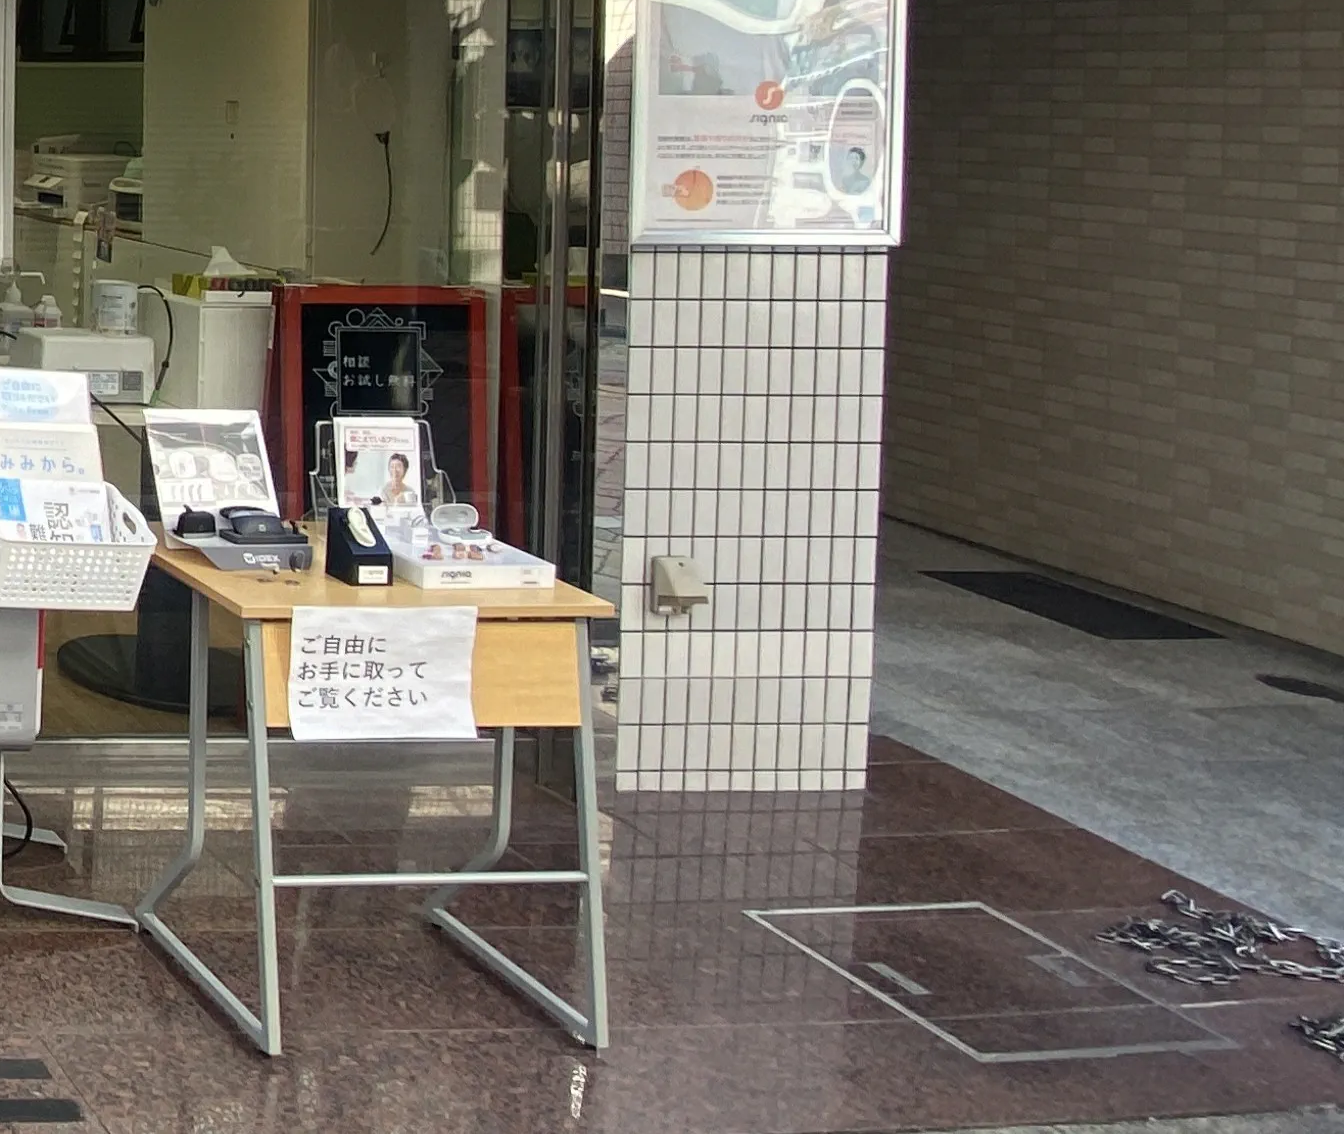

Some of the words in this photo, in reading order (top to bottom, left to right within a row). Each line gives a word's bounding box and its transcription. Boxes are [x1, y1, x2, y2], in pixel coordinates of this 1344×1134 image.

[300, 635, 387, 656] ご自由に
[297, 660, 429, 681] お手に取って
[297, 687, 429, 710] ご覧ください
